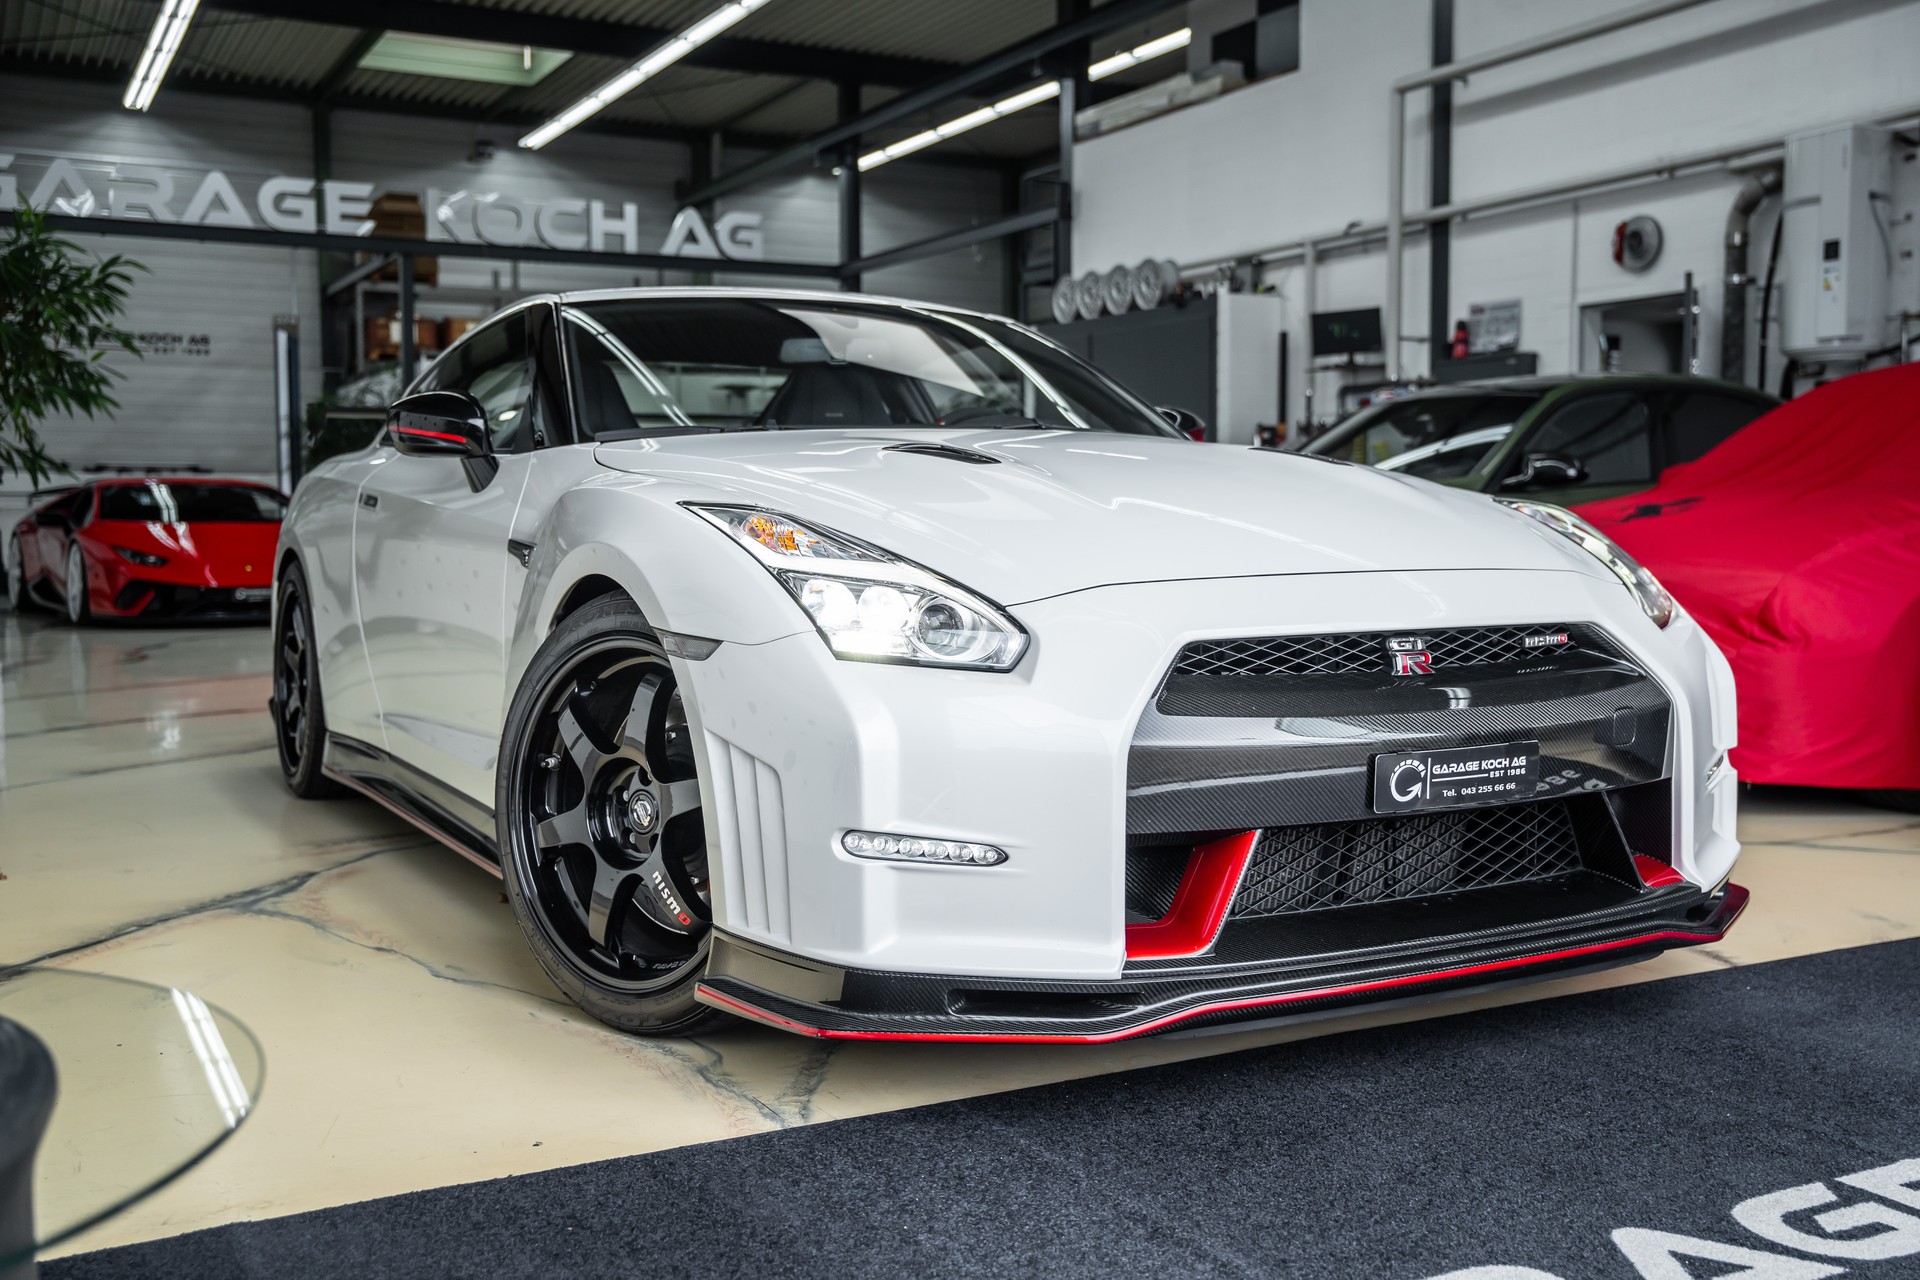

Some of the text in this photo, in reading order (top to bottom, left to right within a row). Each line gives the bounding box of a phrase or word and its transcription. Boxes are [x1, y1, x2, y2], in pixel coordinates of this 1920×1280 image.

[0, 153, 764, 262] ARAGE KOCH AG
[1432, 756, 1526, 775] GARAGE KOCH AG
[1507, 768, 1526, 776] 1986
[1442, 790, 1457, 798] Tel.
[1461, 788, 1476, 796] 043
[1478, 786, 1493, 794] 255
